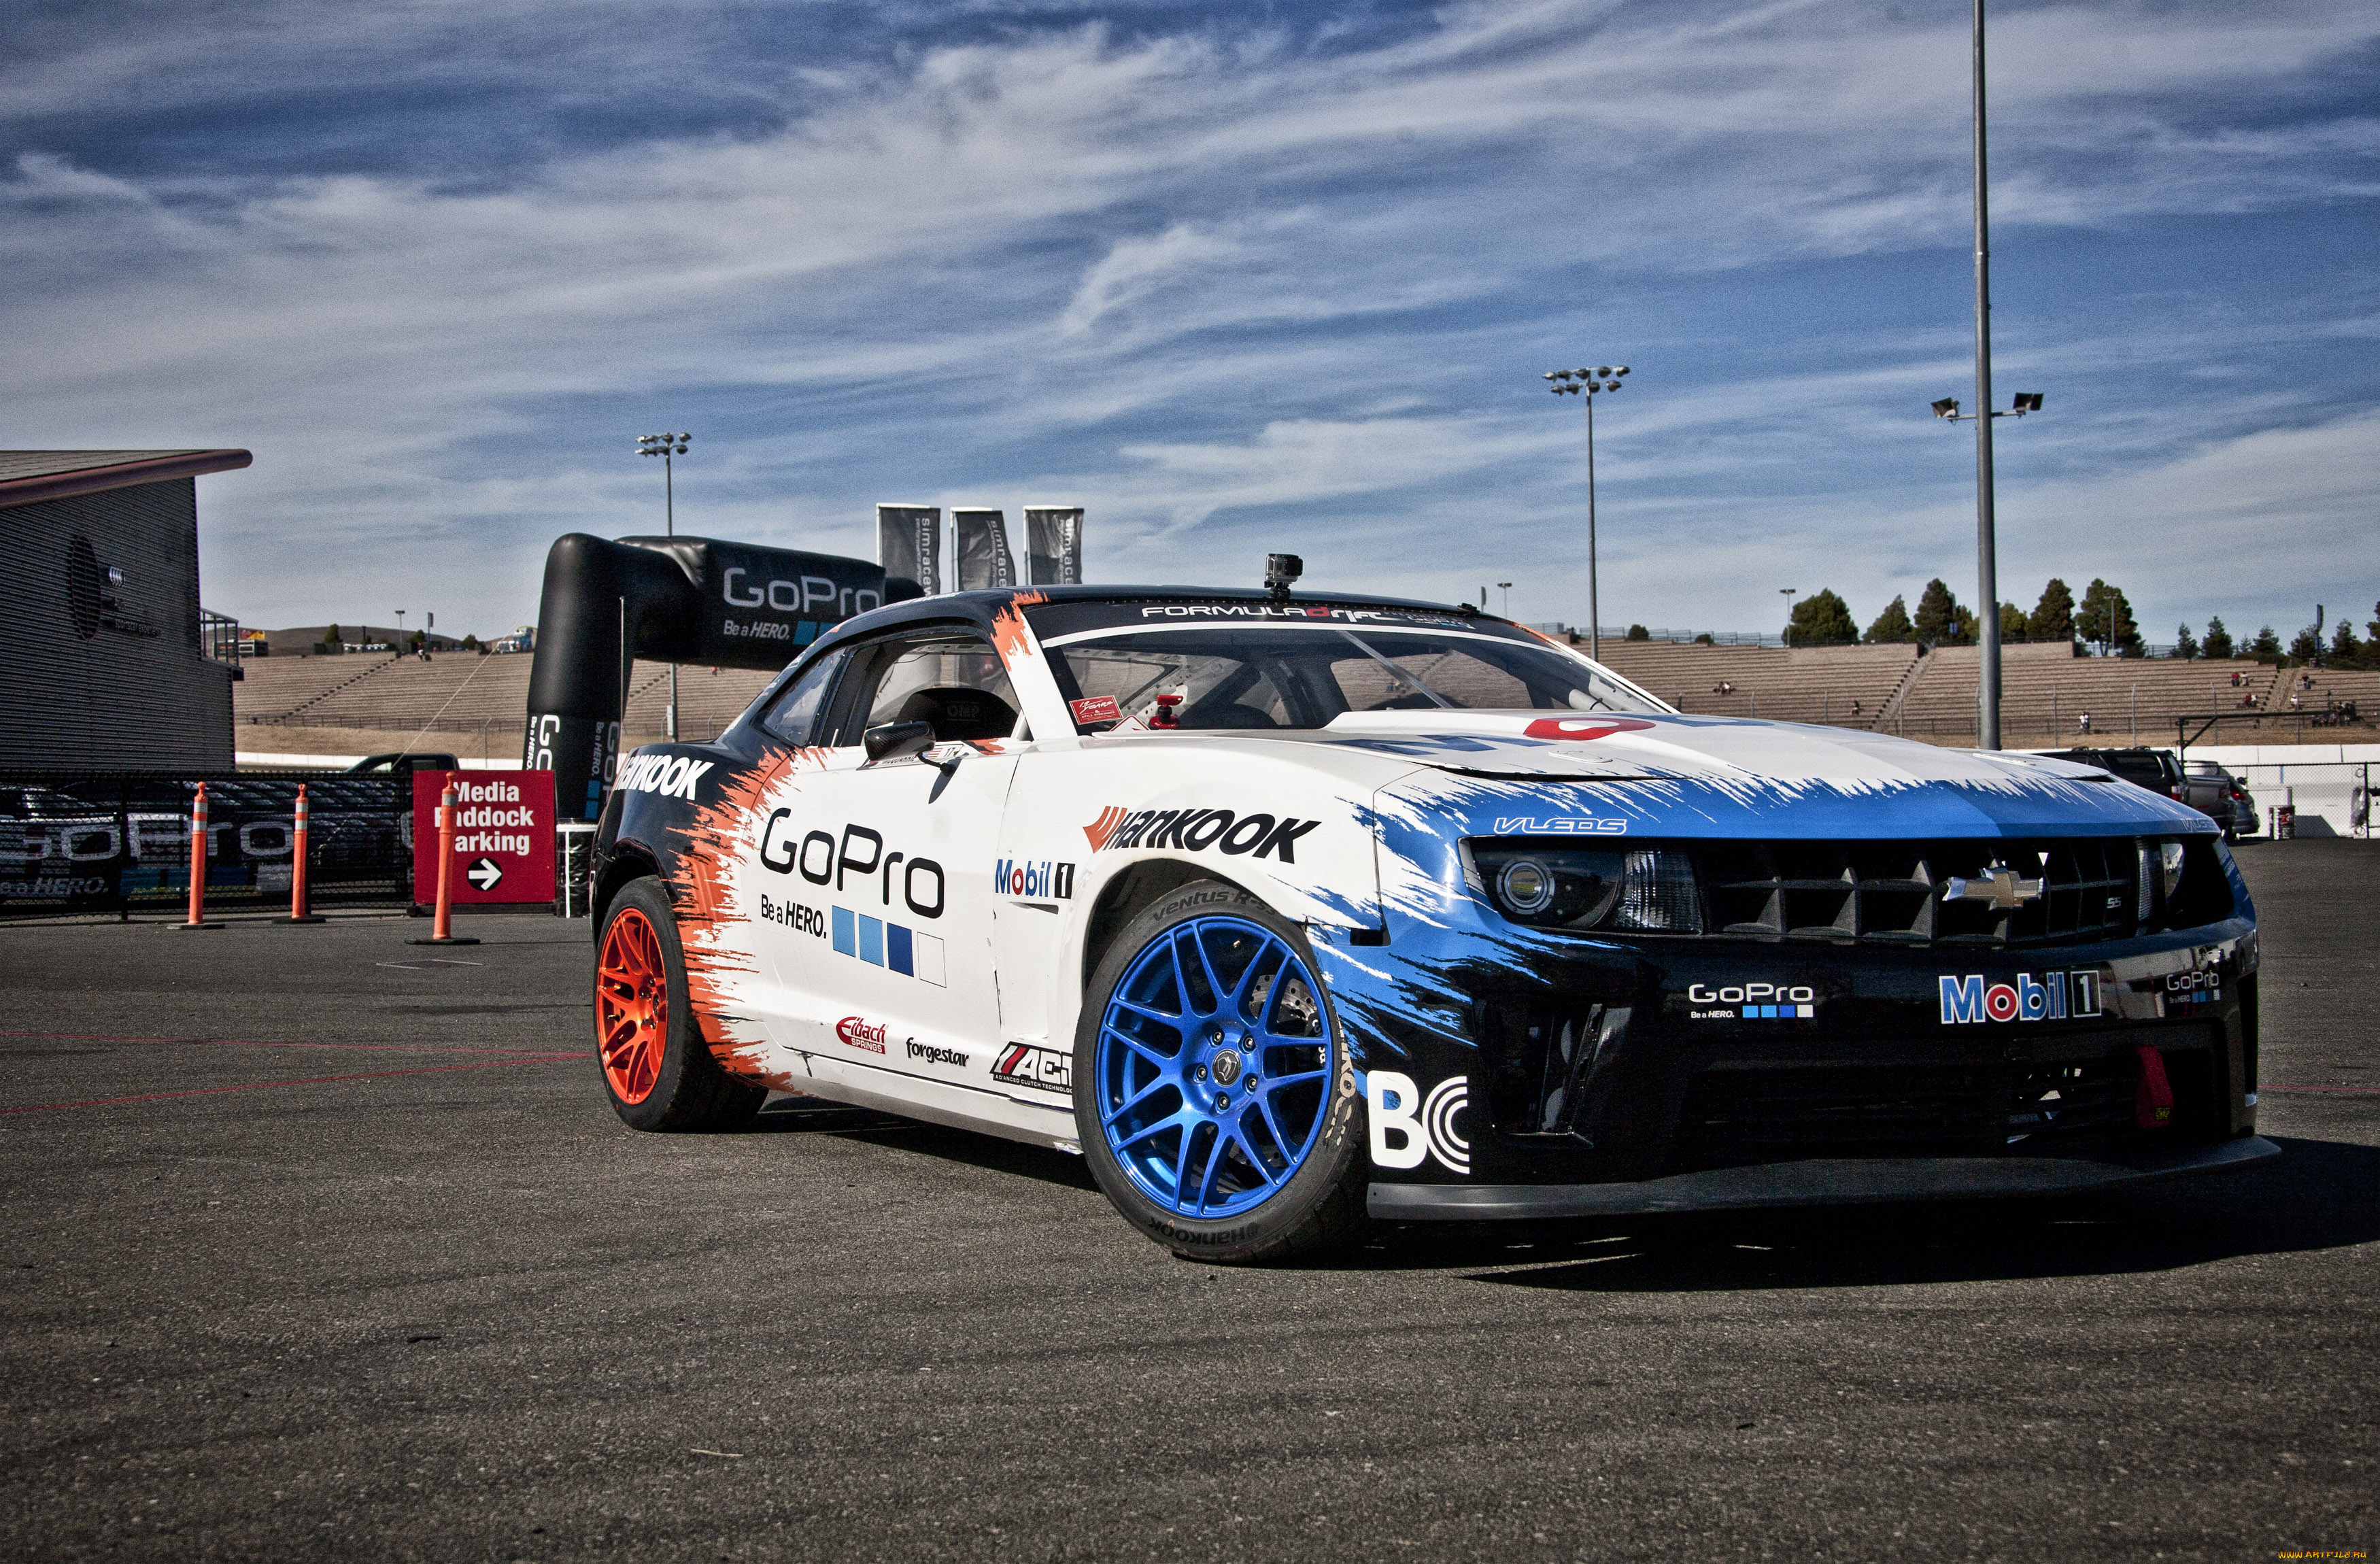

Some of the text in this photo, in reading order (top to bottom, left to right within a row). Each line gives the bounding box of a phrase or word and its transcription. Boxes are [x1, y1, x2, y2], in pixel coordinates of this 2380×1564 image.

[724, 567, 881, 616] GoPro
[724, 619, 790, 639] Be a HERO.
[453, 781, 520, 802] Media
[455, 831, 530, 856] arking
[760, 807, 945, 919] GoPro
[995, 859, 1052, 898] Mobil
[762, 894, 827, 940] Be a HERO.
[1688, 983, 1813, 1002] GoPro
[2166, 971, 2220, 991] GoPro
[1939, 972, 2067, 1024] Mobil
[836, 1017, 886, 1045] Eibach
[851, 1038, 883, 1053] SPRINGS
[906, 1037, 970, 1067] forgestar
[996, 1074, 1020, 1083] ADANCED
[1021, 1079, 1041, 1087] CLUTCH
